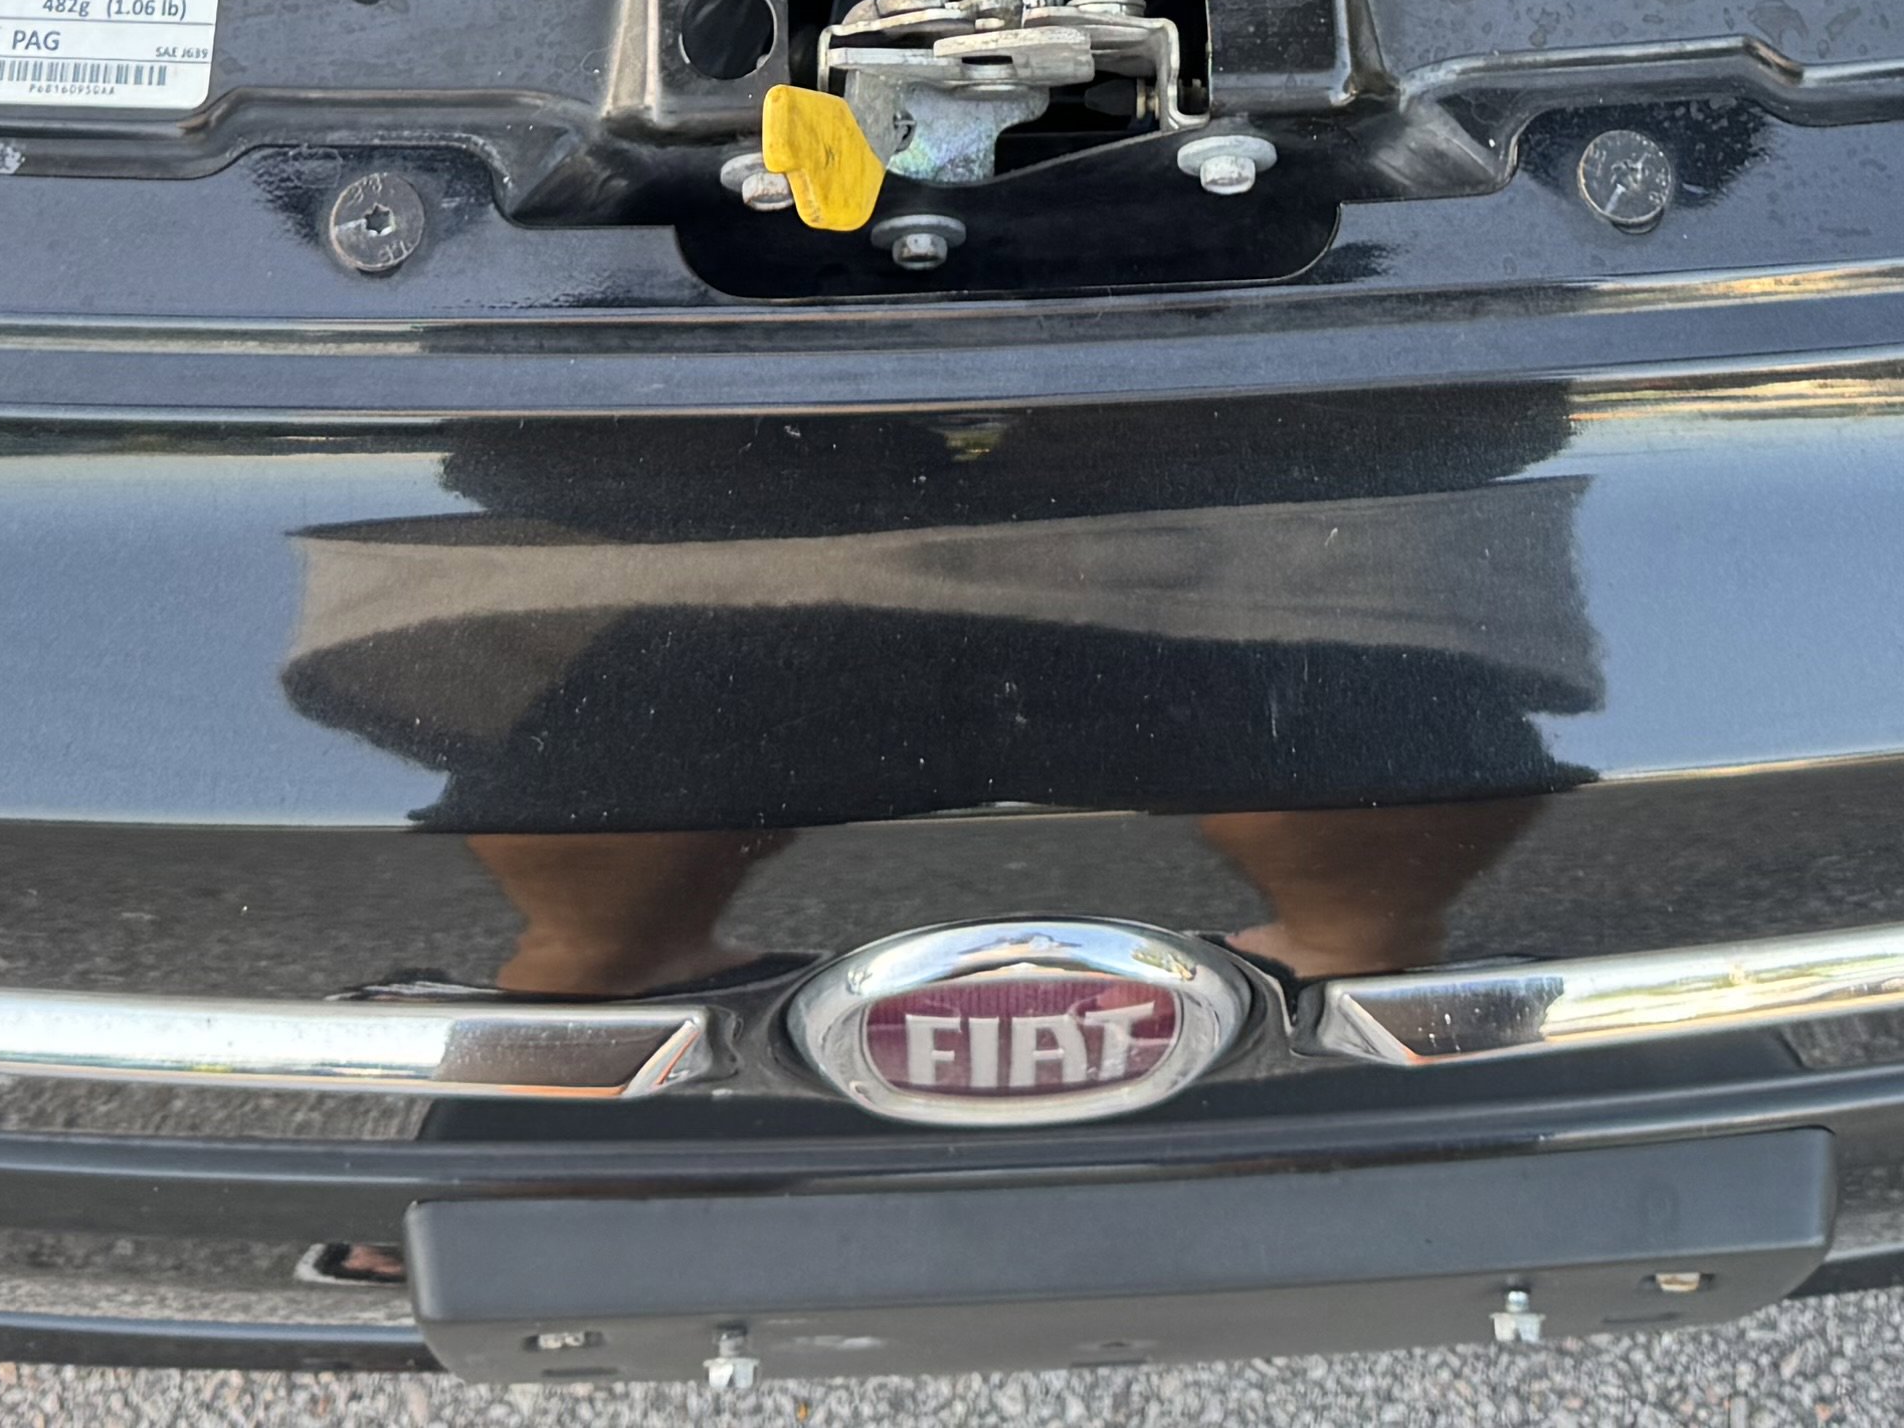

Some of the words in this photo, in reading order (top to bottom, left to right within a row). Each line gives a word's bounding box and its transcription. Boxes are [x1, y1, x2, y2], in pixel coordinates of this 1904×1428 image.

[12, 28, 61, 51] PAG
[155, 46, 177, 58] SAE
[180, 47, 208, 59] J639
[905, 1001, 1154, 1089] FIAT
